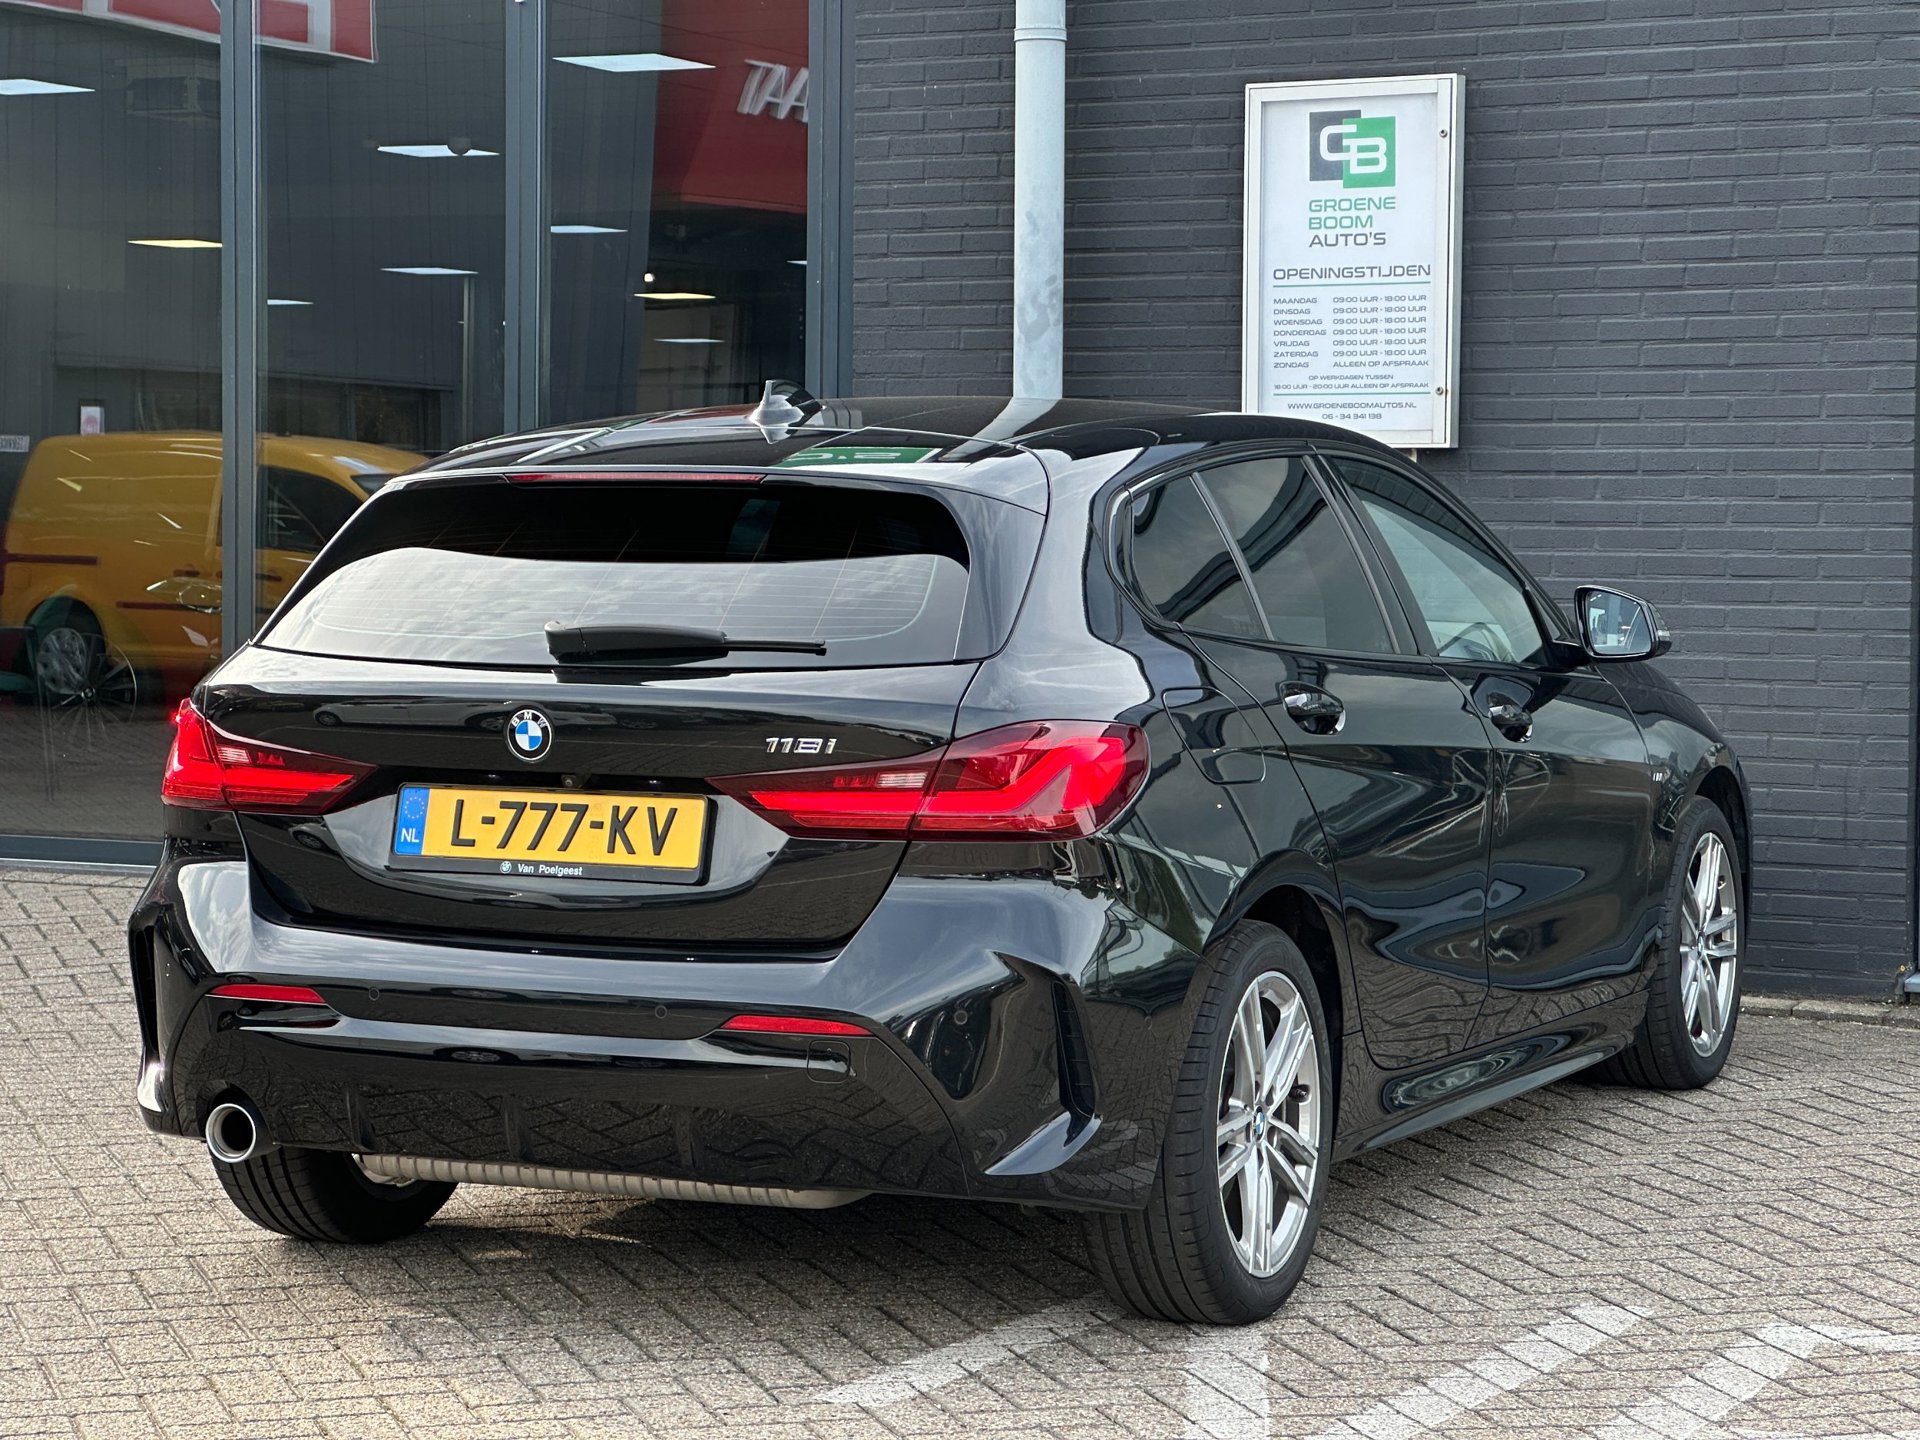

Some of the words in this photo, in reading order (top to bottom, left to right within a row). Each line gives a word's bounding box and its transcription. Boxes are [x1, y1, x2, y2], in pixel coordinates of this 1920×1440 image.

[1309, 197, 1396, 212] GROENE
[1308, 215, 1373, 230] BOOM
[1308, 232, 1386, 248] AUTO'S
[1273, 265, 1431, 280] OPENINGSTIJDEN
[512, 712, 548, 728] BMW
[766, 737, 837, 754] 118i
[450, 799, 678, 856] L-777-KV
[400, 828, 420, 844] NL
[518, 864, 534, 873] Van
[538, 864, 583, 876] Poelgeest
